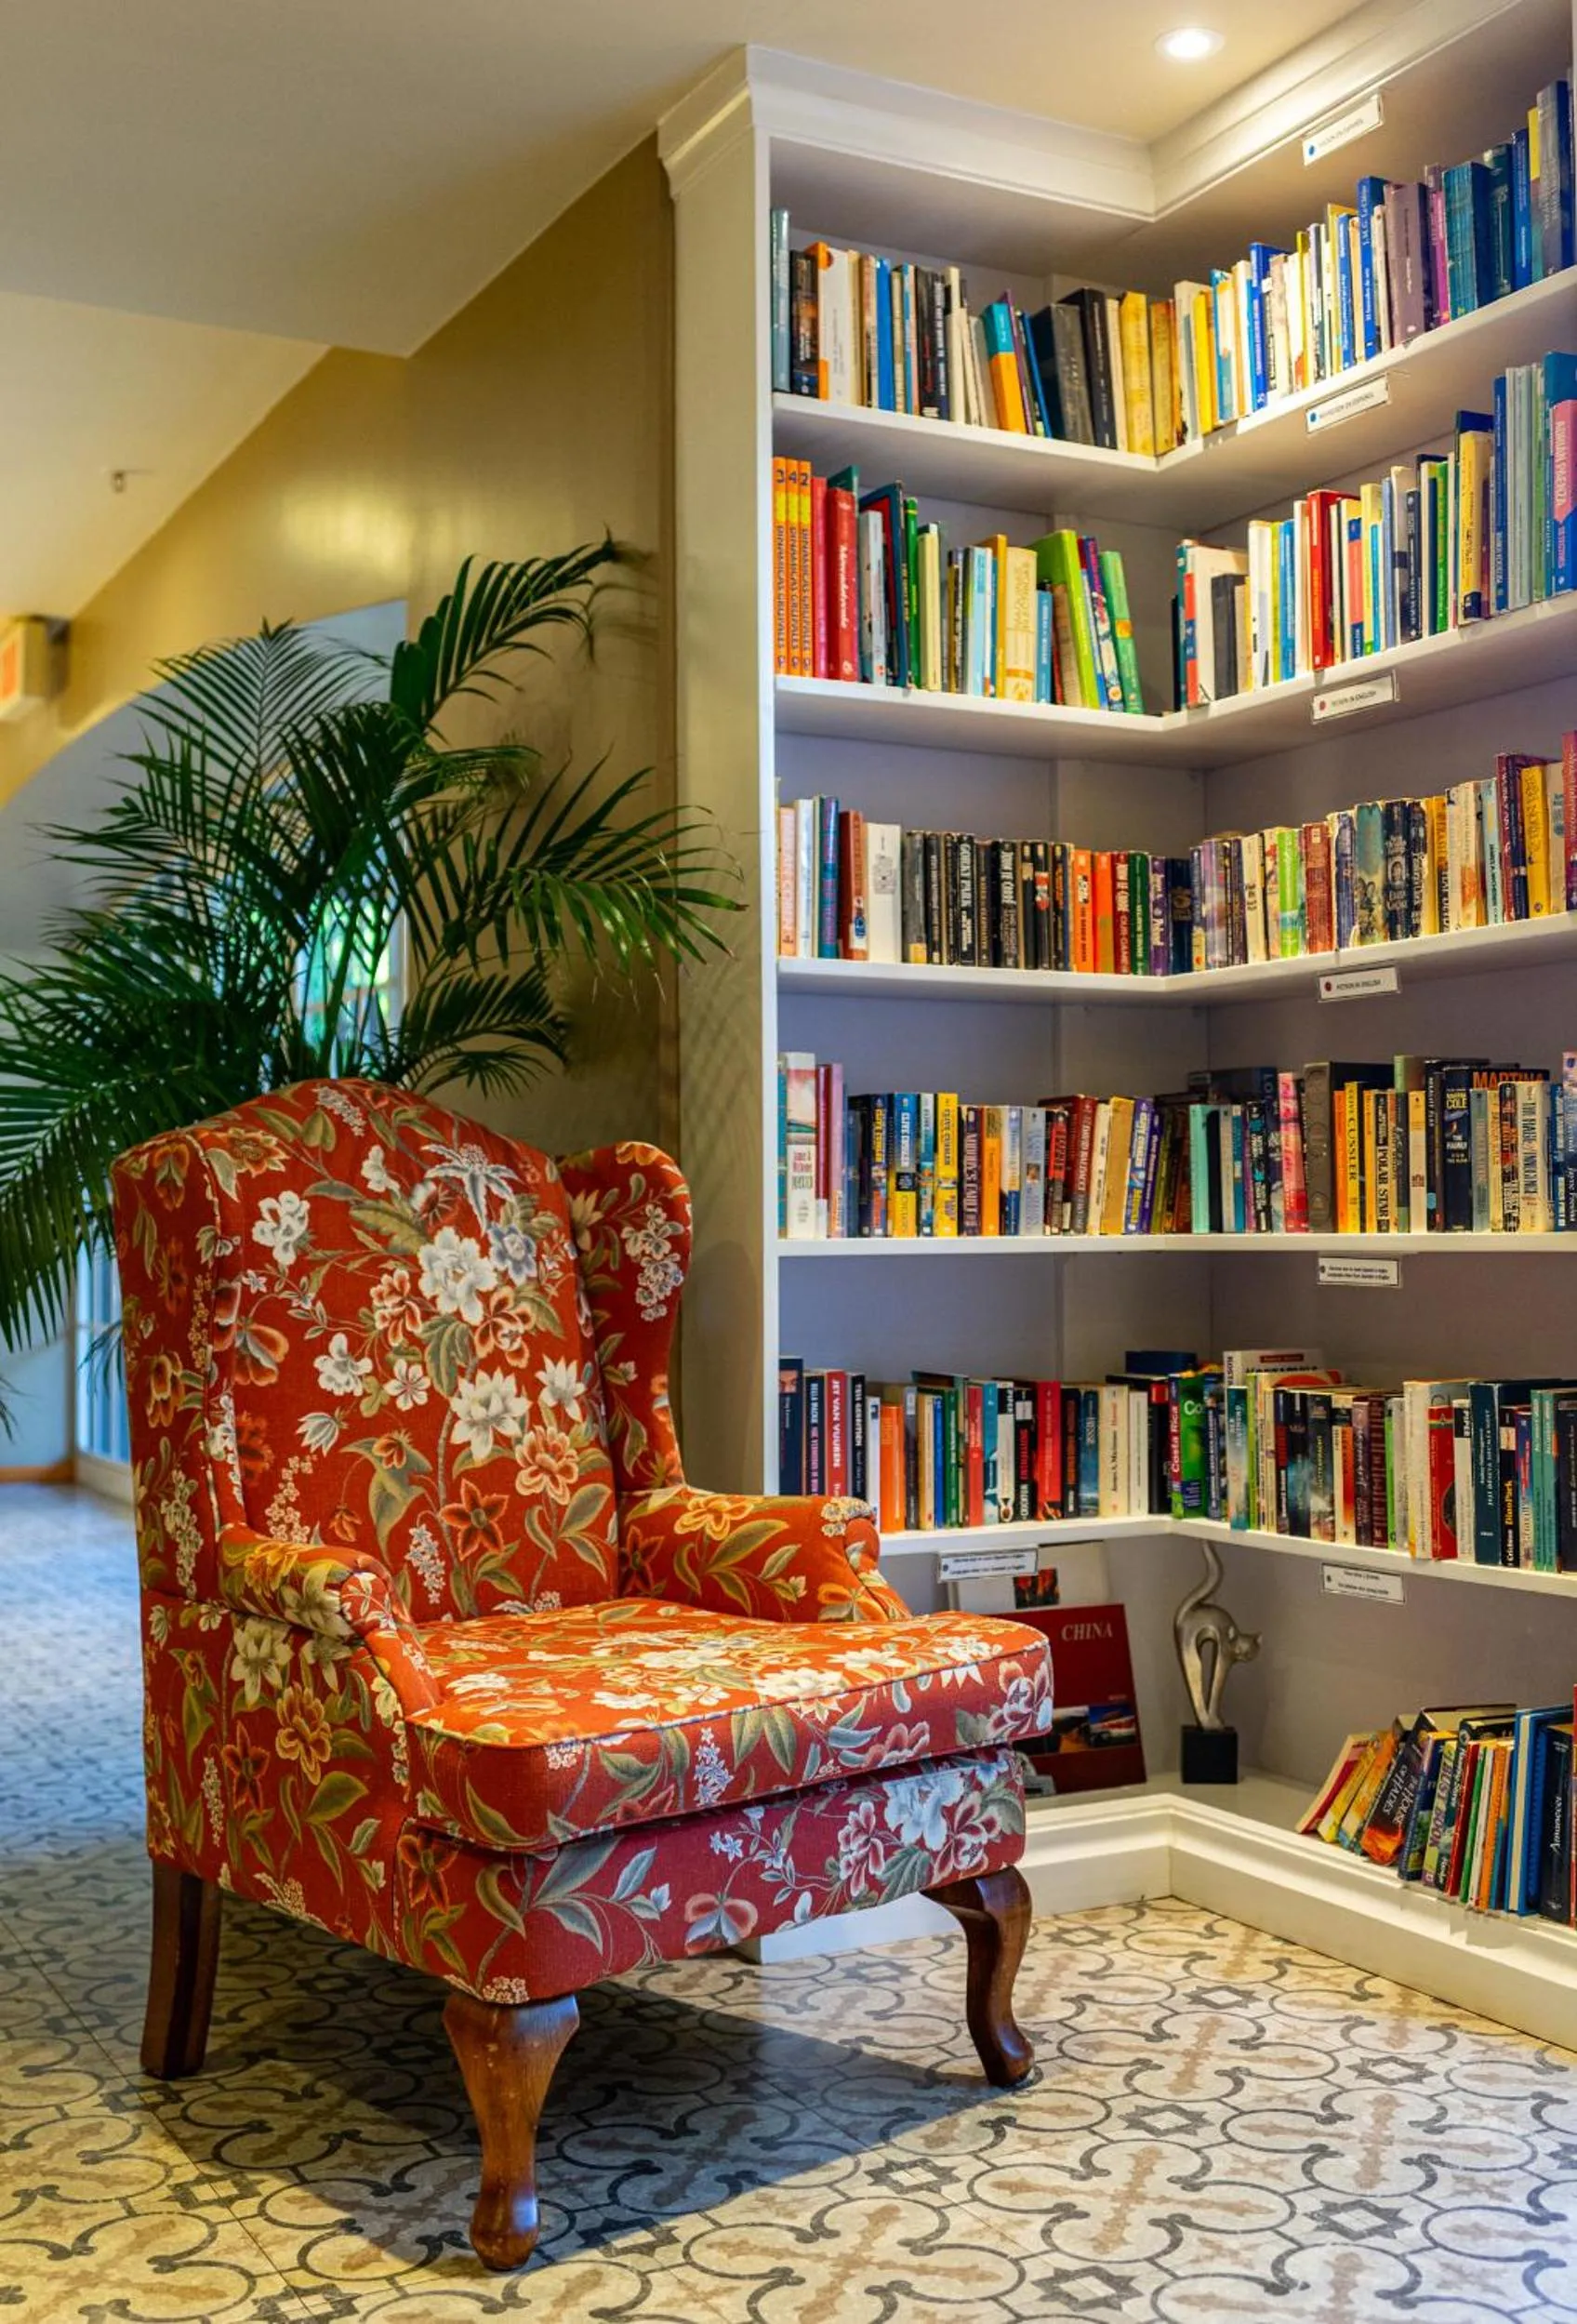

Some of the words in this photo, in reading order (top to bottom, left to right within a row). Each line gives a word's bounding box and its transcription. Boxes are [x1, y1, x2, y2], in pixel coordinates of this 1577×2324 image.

[1348, 1117, 1357, 1180] CUSSLER
[1378, 1149, 1388, 1185] POLAR
[1378, 1189, 1388, 1217] STAR
[832, 1379, 841, 1396] JET
[832, 1398, 841, 1421] VAN
[1170, 1406, 1178, 1433] Rica
[1463, 1410, 1471, 1438] PIPER
[832, 1424, 842, 1468] VUUREN
[1171, 1435, 1179, 1474] Costa
[1061, 1622, 1113, 1641] CHINA
[1383, 1774, 1406, 1816] HADES
